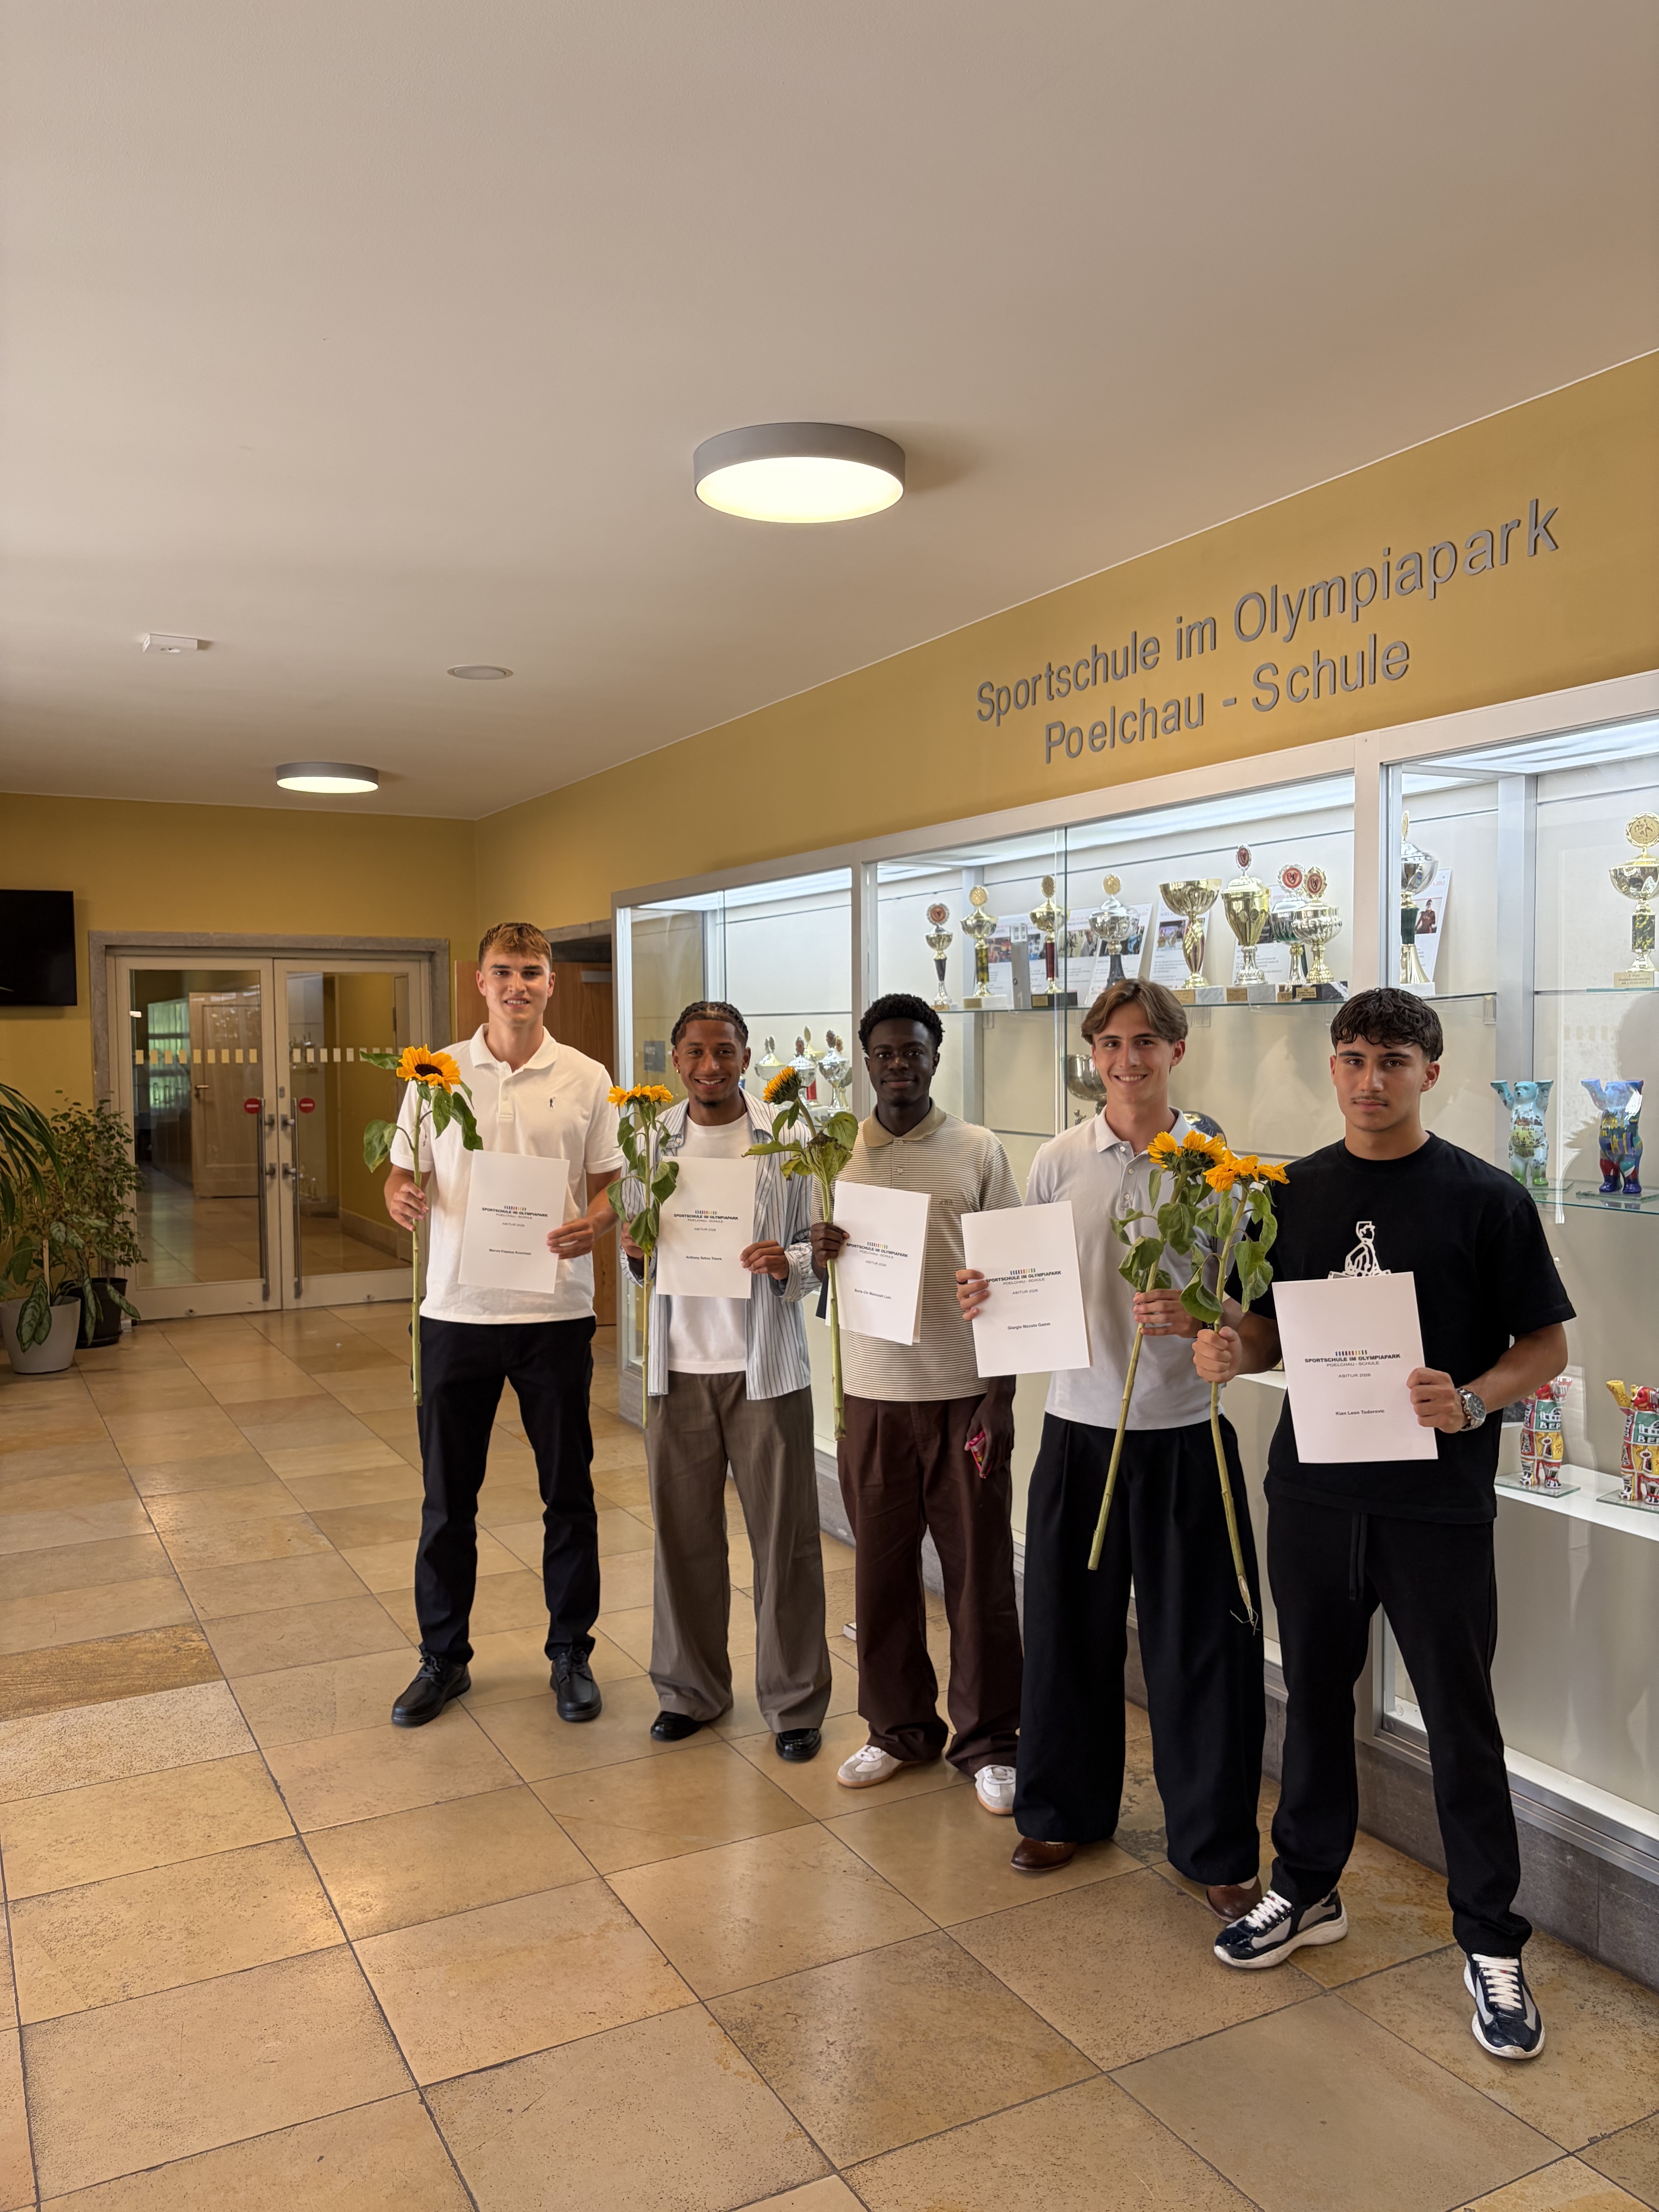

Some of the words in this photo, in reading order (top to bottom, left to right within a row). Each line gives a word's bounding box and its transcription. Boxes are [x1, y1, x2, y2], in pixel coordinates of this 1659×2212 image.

[976, 630, 1160, 727] Sportschule
[1176, 615, 1216, 661] im
[1233, 498, 1559, 643] Olympiapark
[1044, 693, 1204, 764] Poelchau
[1222, 697, 1237, 708] -
[1251, 633, 1410, 713] Schule
[847, 1243, 874, 1251] SPORTSCHULE
[881, 1249, 908, 1257] OLYMPIAPARK
